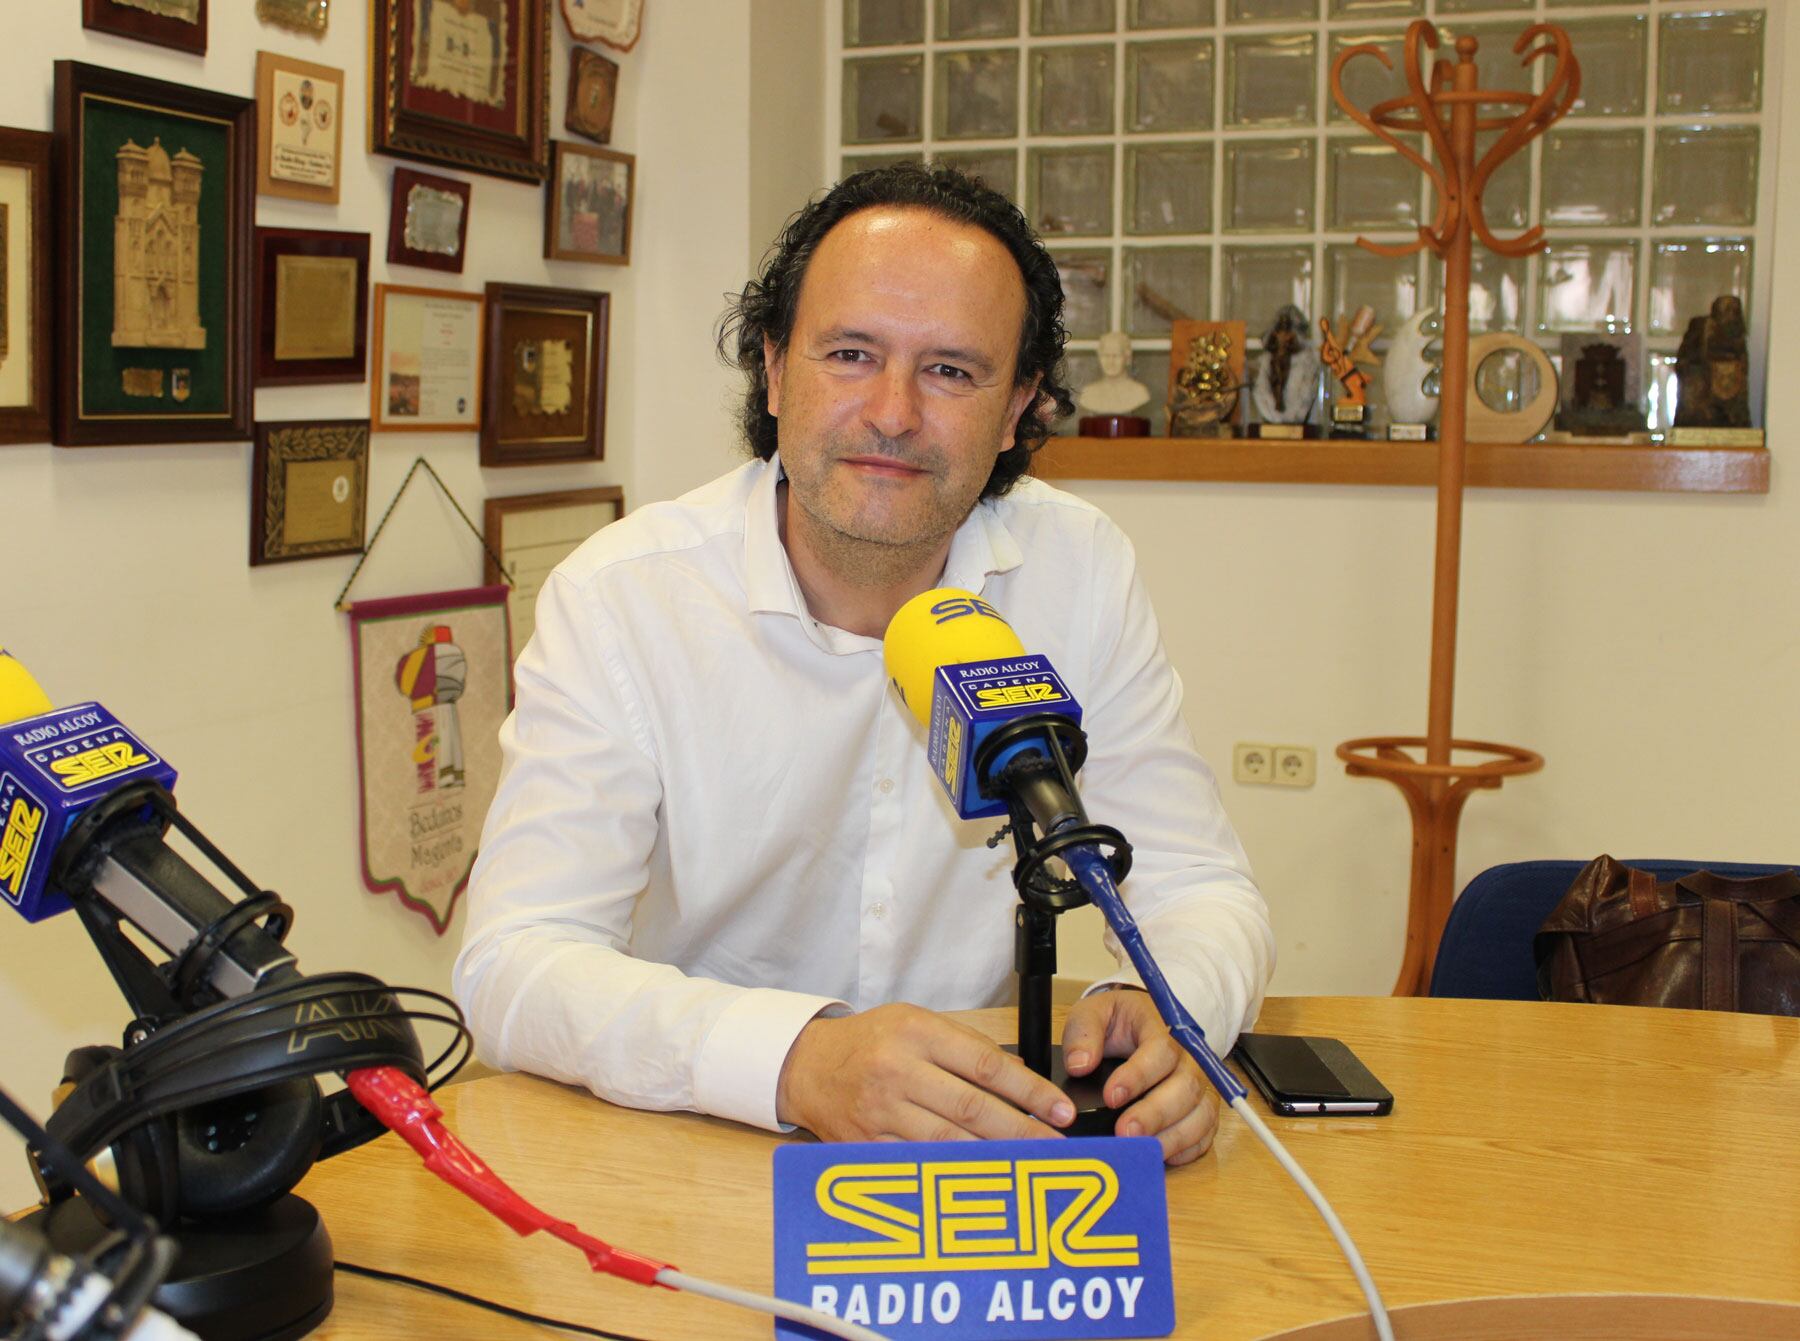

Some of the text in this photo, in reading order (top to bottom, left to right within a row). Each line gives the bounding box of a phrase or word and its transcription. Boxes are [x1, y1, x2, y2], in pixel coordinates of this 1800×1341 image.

[959, 660, 1040, 679] RADIO ALCOY
[968, 675, 1051, 690] CADENA
[976, 683, 1062, 708] SER
[13, 712, 103, 746] RADIO ALCOY
[35, 731, 125, 763] CADENA
[50, 741, 150, 787] SER
[945, 716, 961, 797] SER
[0, 798, 42, 896] SER
[806, 1158, 1140, 1275] SER
[810, 1276, 1144, 1326] RADIO ALCOY
